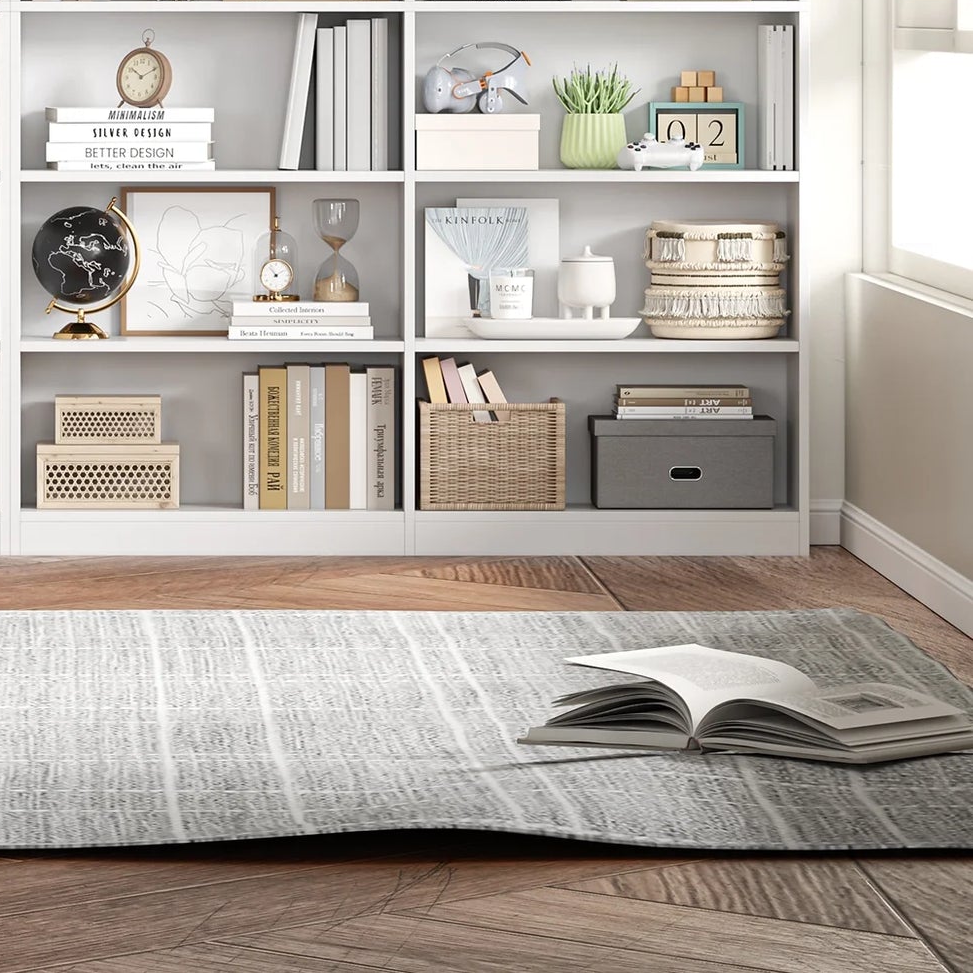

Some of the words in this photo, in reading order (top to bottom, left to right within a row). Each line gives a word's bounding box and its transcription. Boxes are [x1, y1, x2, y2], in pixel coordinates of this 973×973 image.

[108, 111, 165, 120] MINIMALISM
[93, 128, 128, 137] SILVER
[134, 128, 172, 137] DESIGN
[708, 120, 724, 146] 2
[85, 148, 126, 158] BETTER
[130, 148, 174, 158] DESIGN
[268, 387, 280, 435] БОЖЕСТВЕННАЯ
[268, 437, 280, 466] КОМЕДИЯ
[374, 424, 387, 478] Триумфальная
[267, 472, 283, 491] РАЙ
[374, 481, 384, 498] арка
